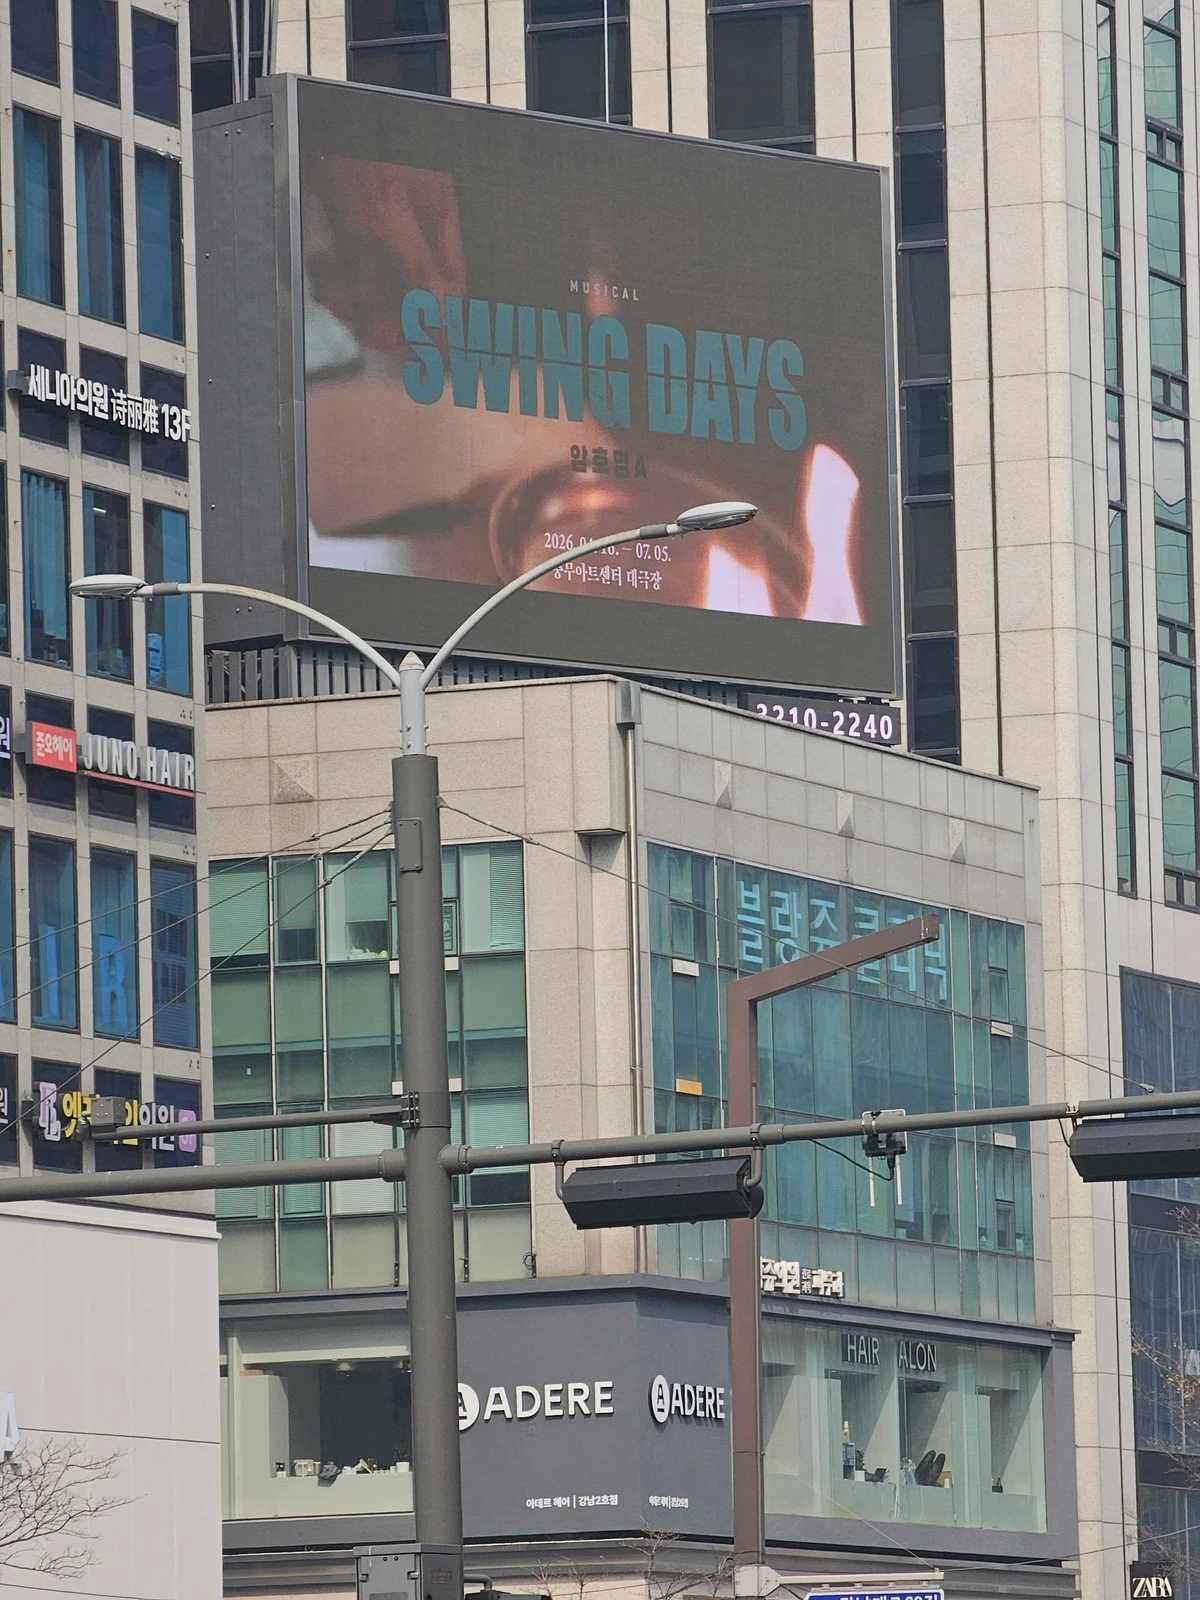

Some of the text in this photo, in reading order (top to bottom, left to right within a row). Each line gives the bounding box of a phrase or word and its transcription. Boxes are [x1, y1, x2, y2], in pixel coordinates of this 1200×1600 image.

[569, 279, 640, 302] MUSICAL
[401, 288, 808, 452] SWING DAYS
[28, 363, 192, 443] 세니아의원 诗丽雅 13F
[626, 568, 662, 591] 대극장
[35, 731, 73, 763] 준오헤어
[83, 732, 195, 791] JUNO HAIR
[847, 1334, 880, 1364] HAIR
[483, 1381, 614, 1420] ADERE
[671, 1383, 726, 1419] ADERE
[525, 1498, 552, 1509] 아데르
[553, 1496, 570, 1508] 헤어
[578, 1494, 619, 1506] 강남2호점
[1132, 1576, 1173, 1598] ZARA
